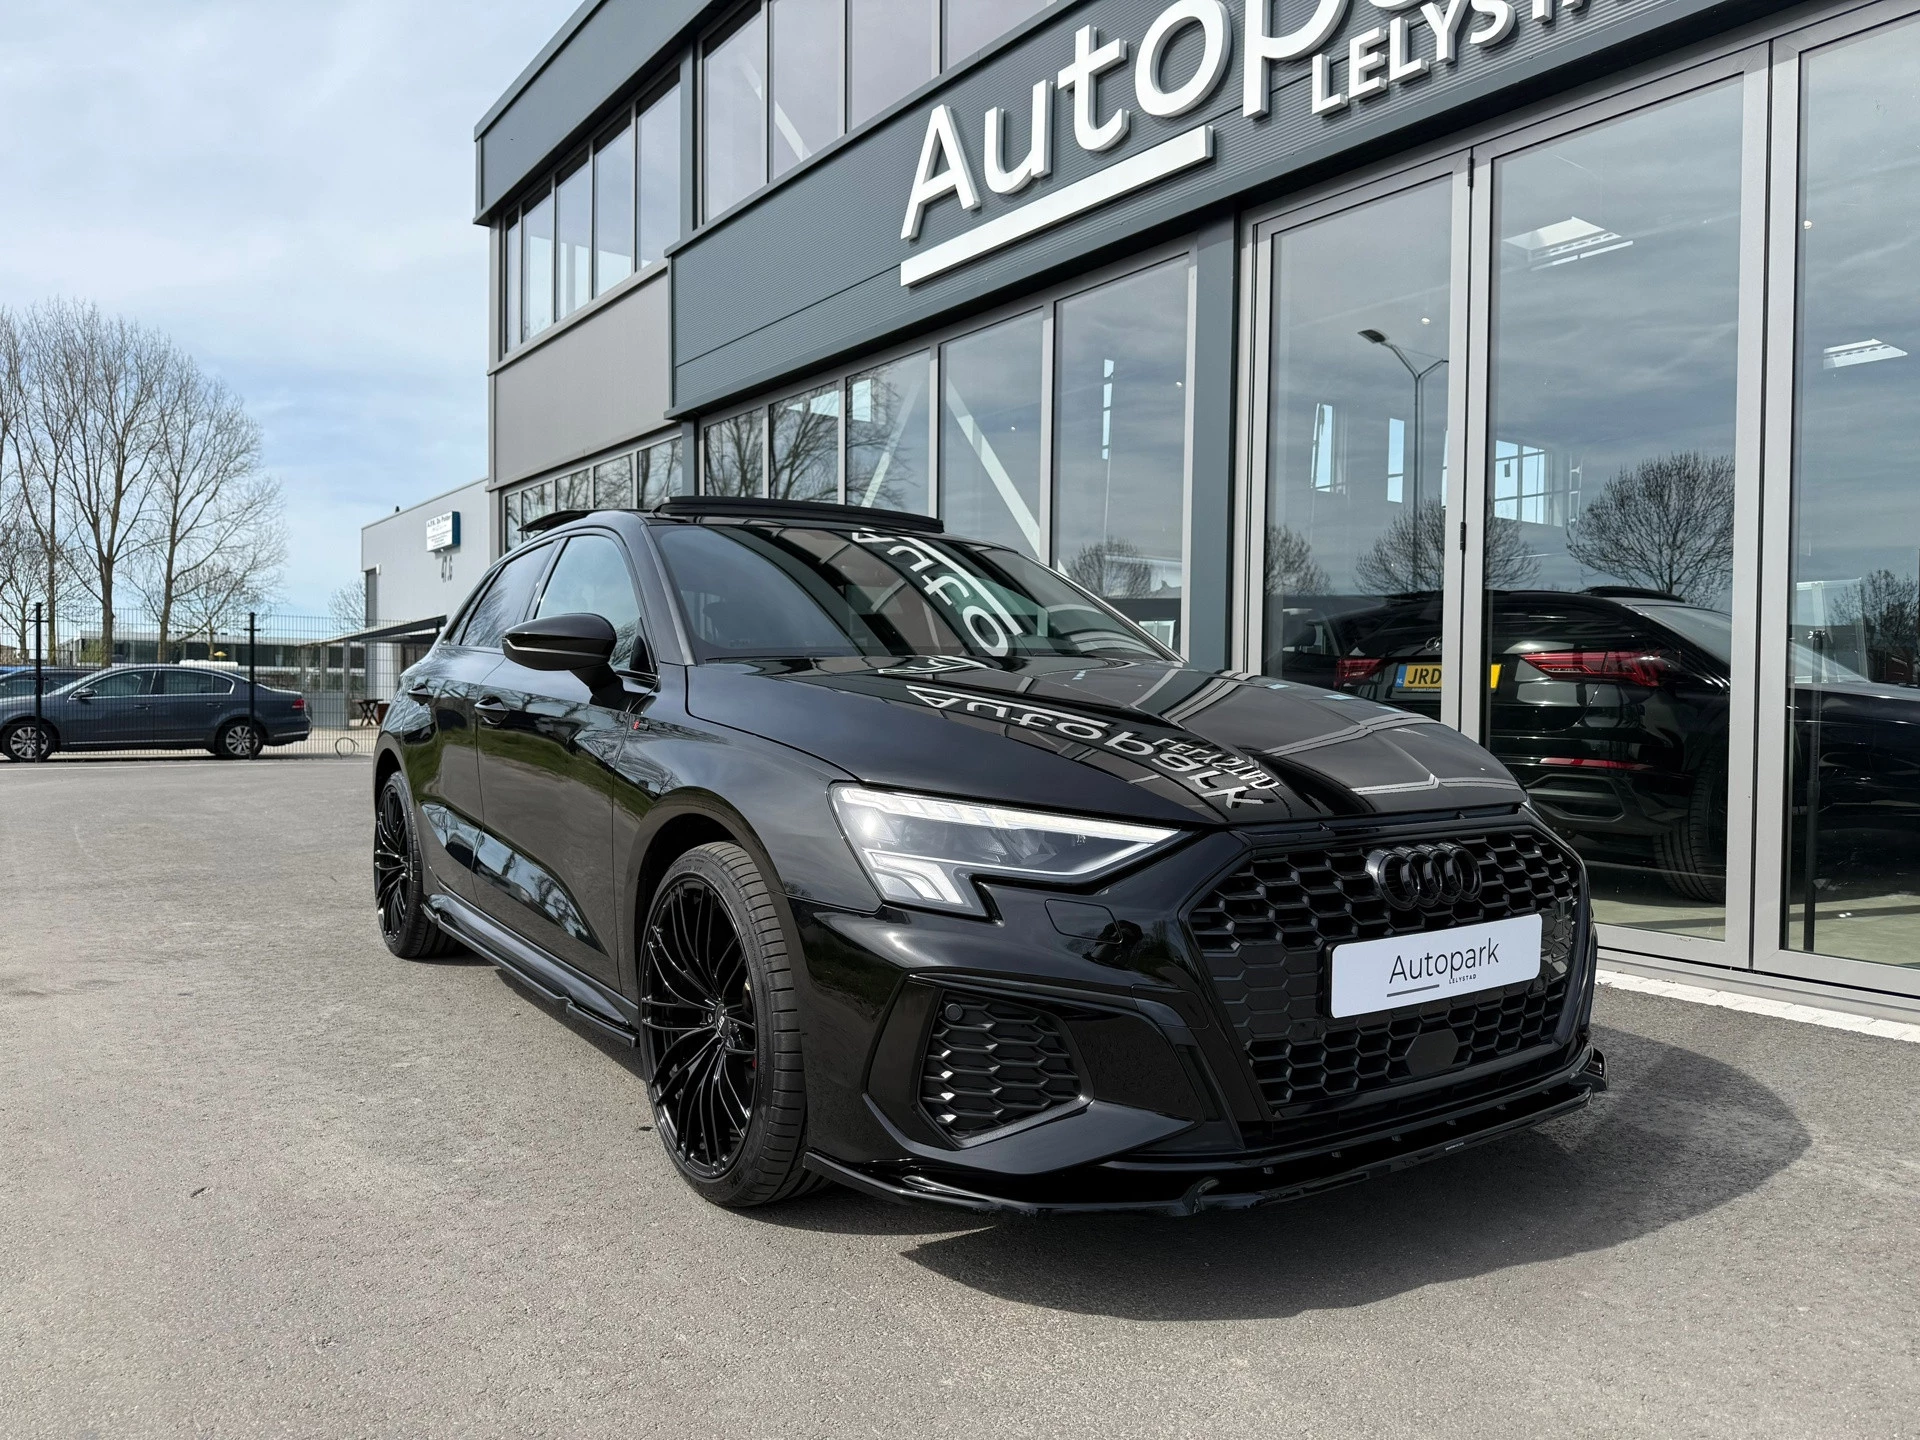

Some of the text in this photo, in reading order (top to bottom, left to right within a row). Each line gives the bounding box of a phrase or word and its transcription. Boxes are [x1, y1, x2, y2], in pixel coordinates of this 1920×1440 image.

[1311, 0, 1588, 115] LELYS
[900, 0, 1425, 241] Autop
[1408, 667, 1442, 685] JRD
[1389, 937, 1499, 984] Autopark
[1448, 973, 1477, 985] LELYSTAD
